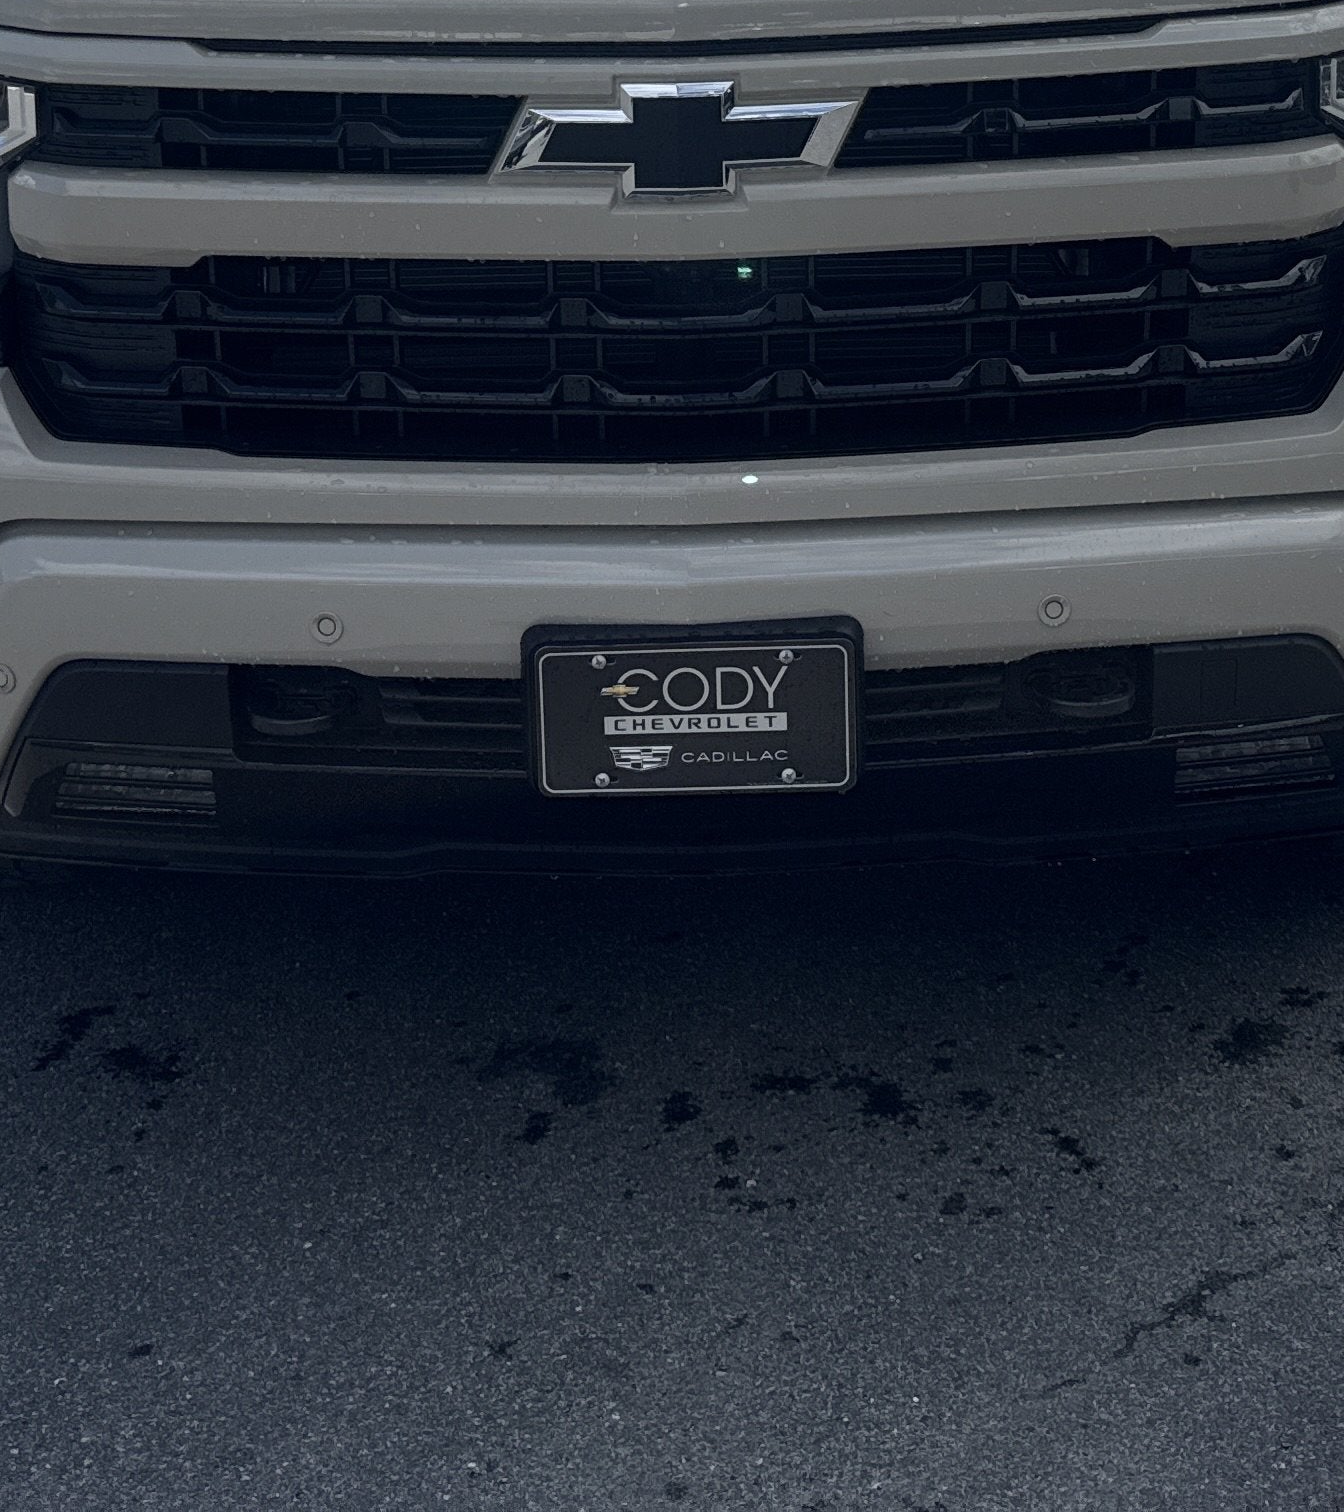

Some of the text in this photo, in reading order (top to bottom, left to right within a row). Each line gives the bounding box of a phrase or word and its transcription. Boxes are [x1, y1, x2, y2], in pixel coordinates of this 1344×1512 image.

[616, 665, 789, 713] CODY
[613, 714, 779, 732] CHEVROLET
[680, 748, 789, 764] CADILLAC
